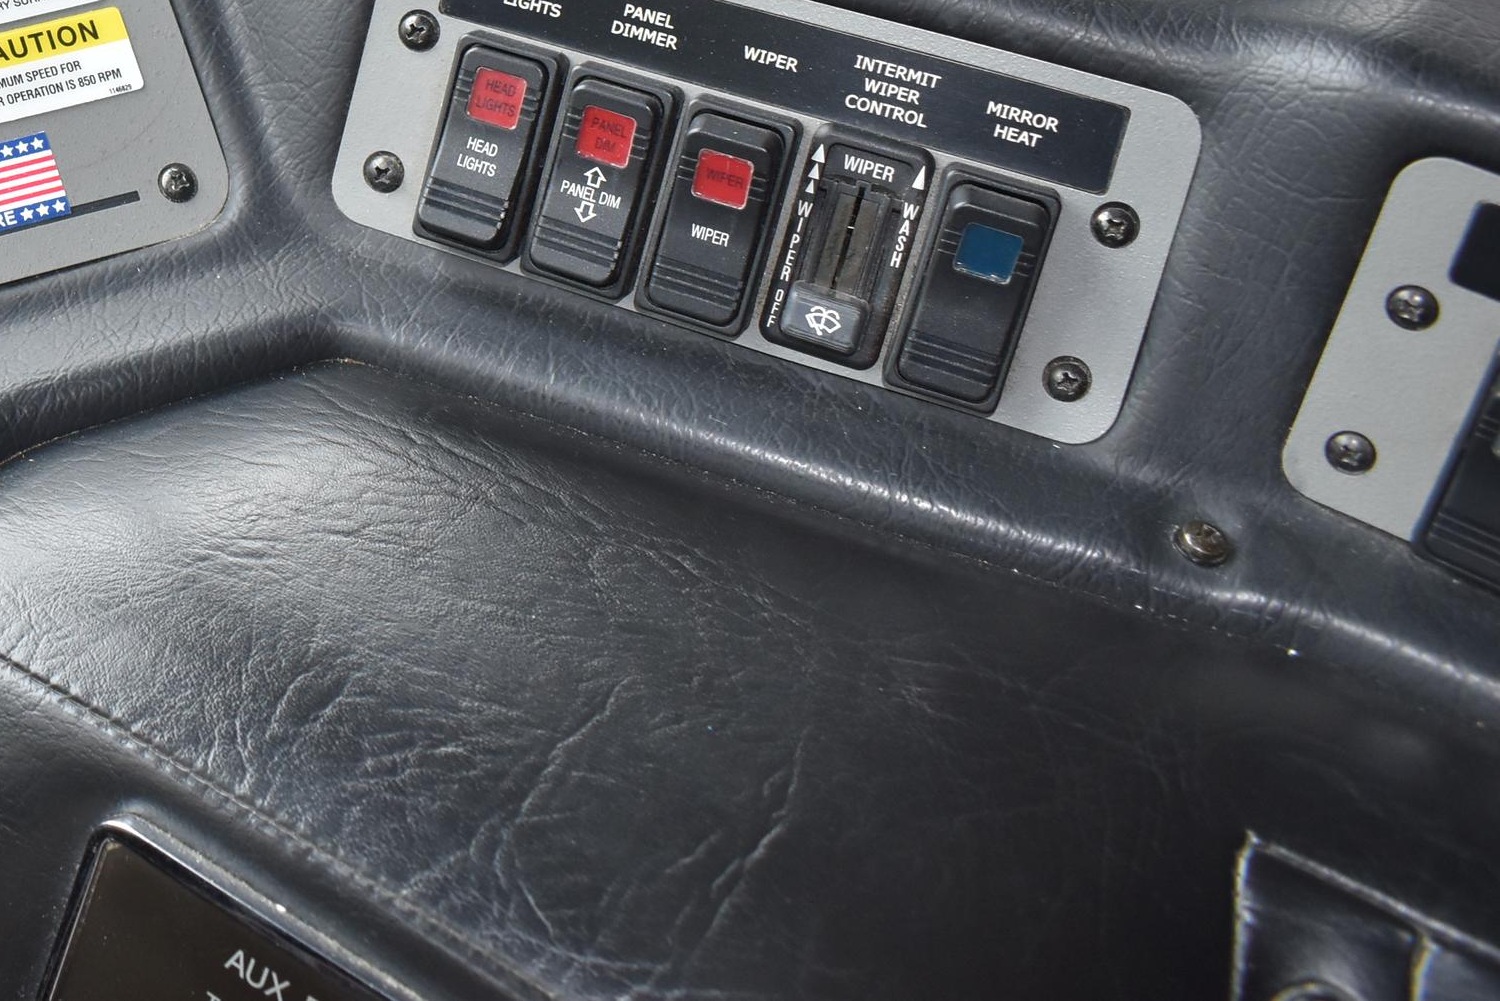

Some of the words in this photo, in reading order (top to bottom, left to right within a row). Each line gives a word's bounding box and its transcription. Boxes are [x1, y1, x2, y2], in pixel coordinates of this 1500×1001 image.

[623, 4, 674, 30] PANEL
[610, 20, 678, 50] DIMMER
[25, 65, 58, 83] SPEED
[60, 60, 82, 76] FOR
[744, 45, 798, 73] WIPER
[854, 55, 942, 88] INTERMIT
[7, 83, 63, 104] OPERATION
[66, 79, 76, 91] IS
[78, 74, 96, 88] 850
[99, 68, 122, 83] RPM
[484, 78, 517, 97] HEAD
[864, 78, 920, 105] WIPER
[473, 97, 516, 118] LIGHTS
[844, 94, 928, 129] CONTROL
[986, 100, 1059, 133] MIRROR
[591, 116, 627, 138] PANEL
[994, 124, 1043, 148] HEAT
[466, 136, 498, 157] HEAD
[456, 155, 497, 177] LIGHTS
[707, 168, 743, 189] WIPER
[844, 154, 895, 183] WIPER
[560, 180, 596, 204] PANEL
[599, 190, 621, 209] DIM
[691, 223, 729, 247] WIPER
[780, 200, 813, 282] WIPER
[889, 202, 920, 268] WASH
[766, 289, 784, 328] OFF
[224, 949, 291, 1001] AUX
